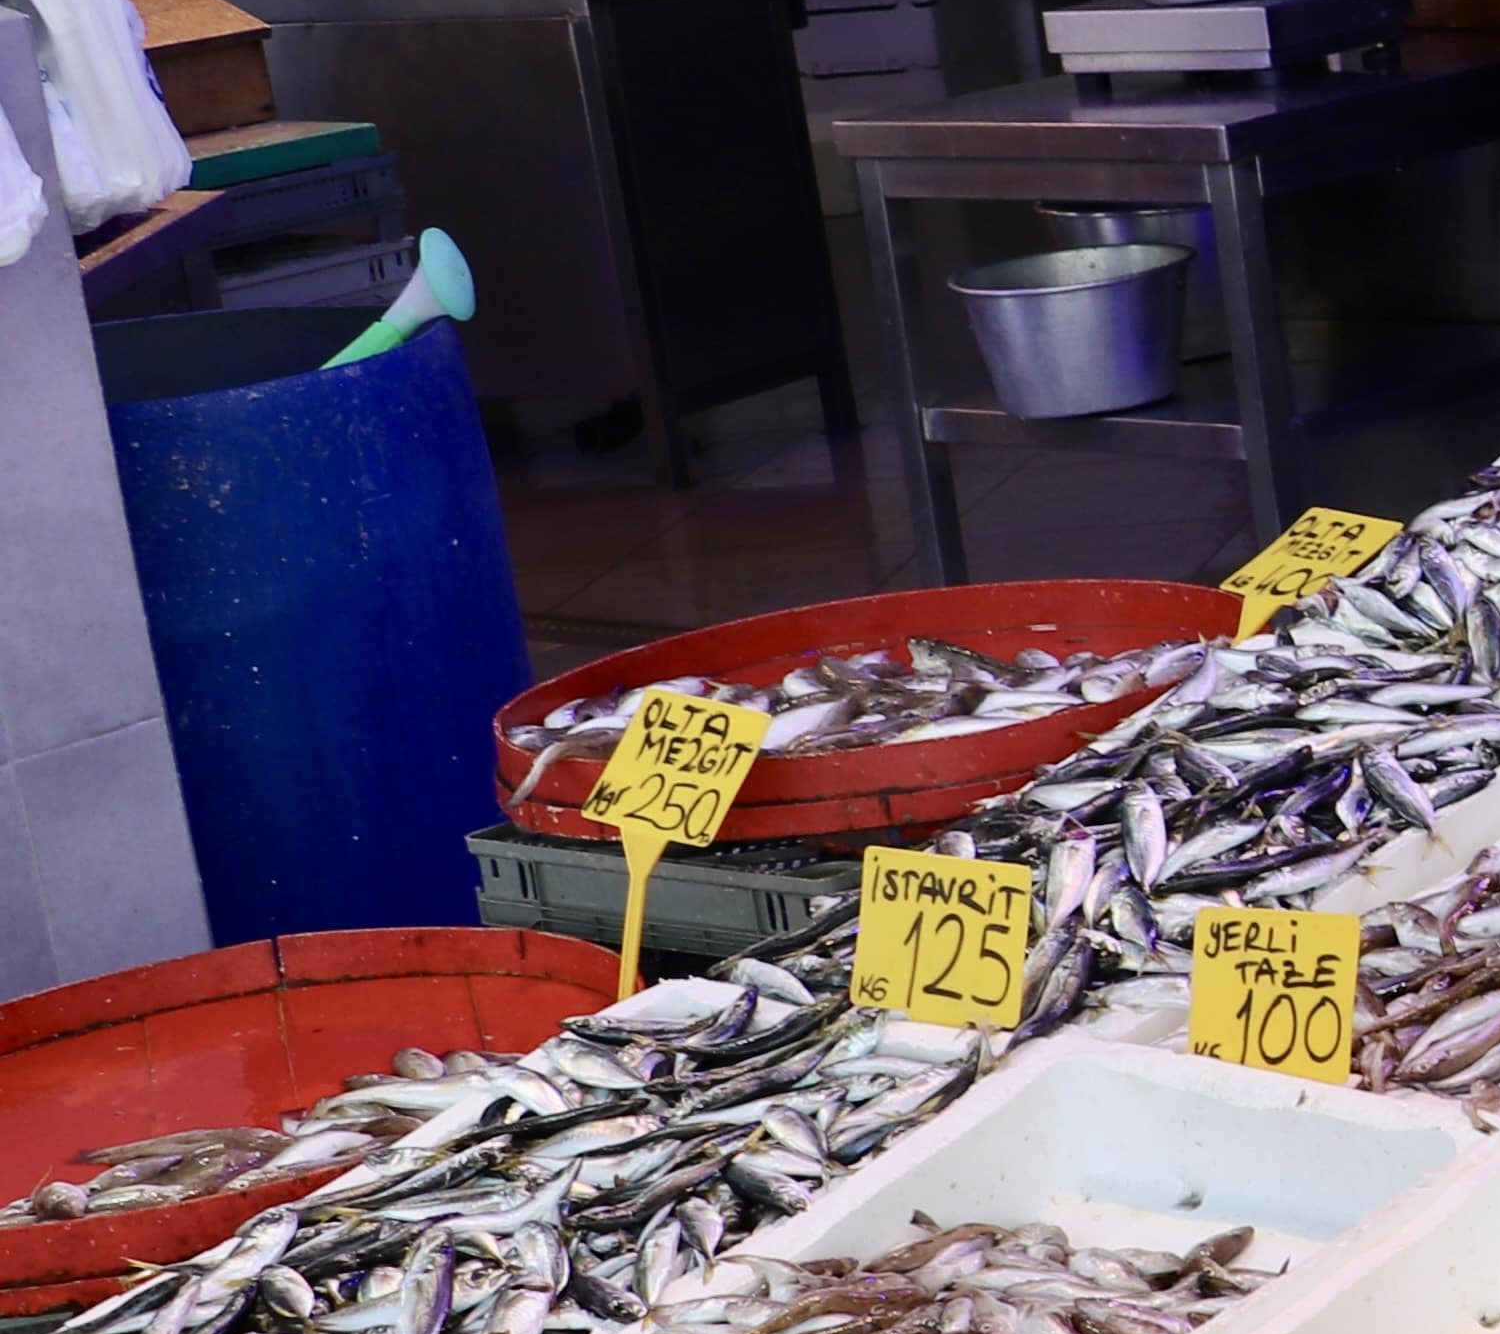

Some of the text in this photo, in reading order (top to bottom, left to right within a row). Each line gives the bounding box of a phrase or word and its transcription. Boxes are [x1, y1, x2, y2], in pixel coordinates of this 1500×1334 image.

[643, 697, 731, 744] OLTA
[622, 773, 721, 840] 250
[903, 911, 1012, 1009] 125
[1234, 953, 1342, 989] TAZE
[1235, 988, 1342, 1065] 100
